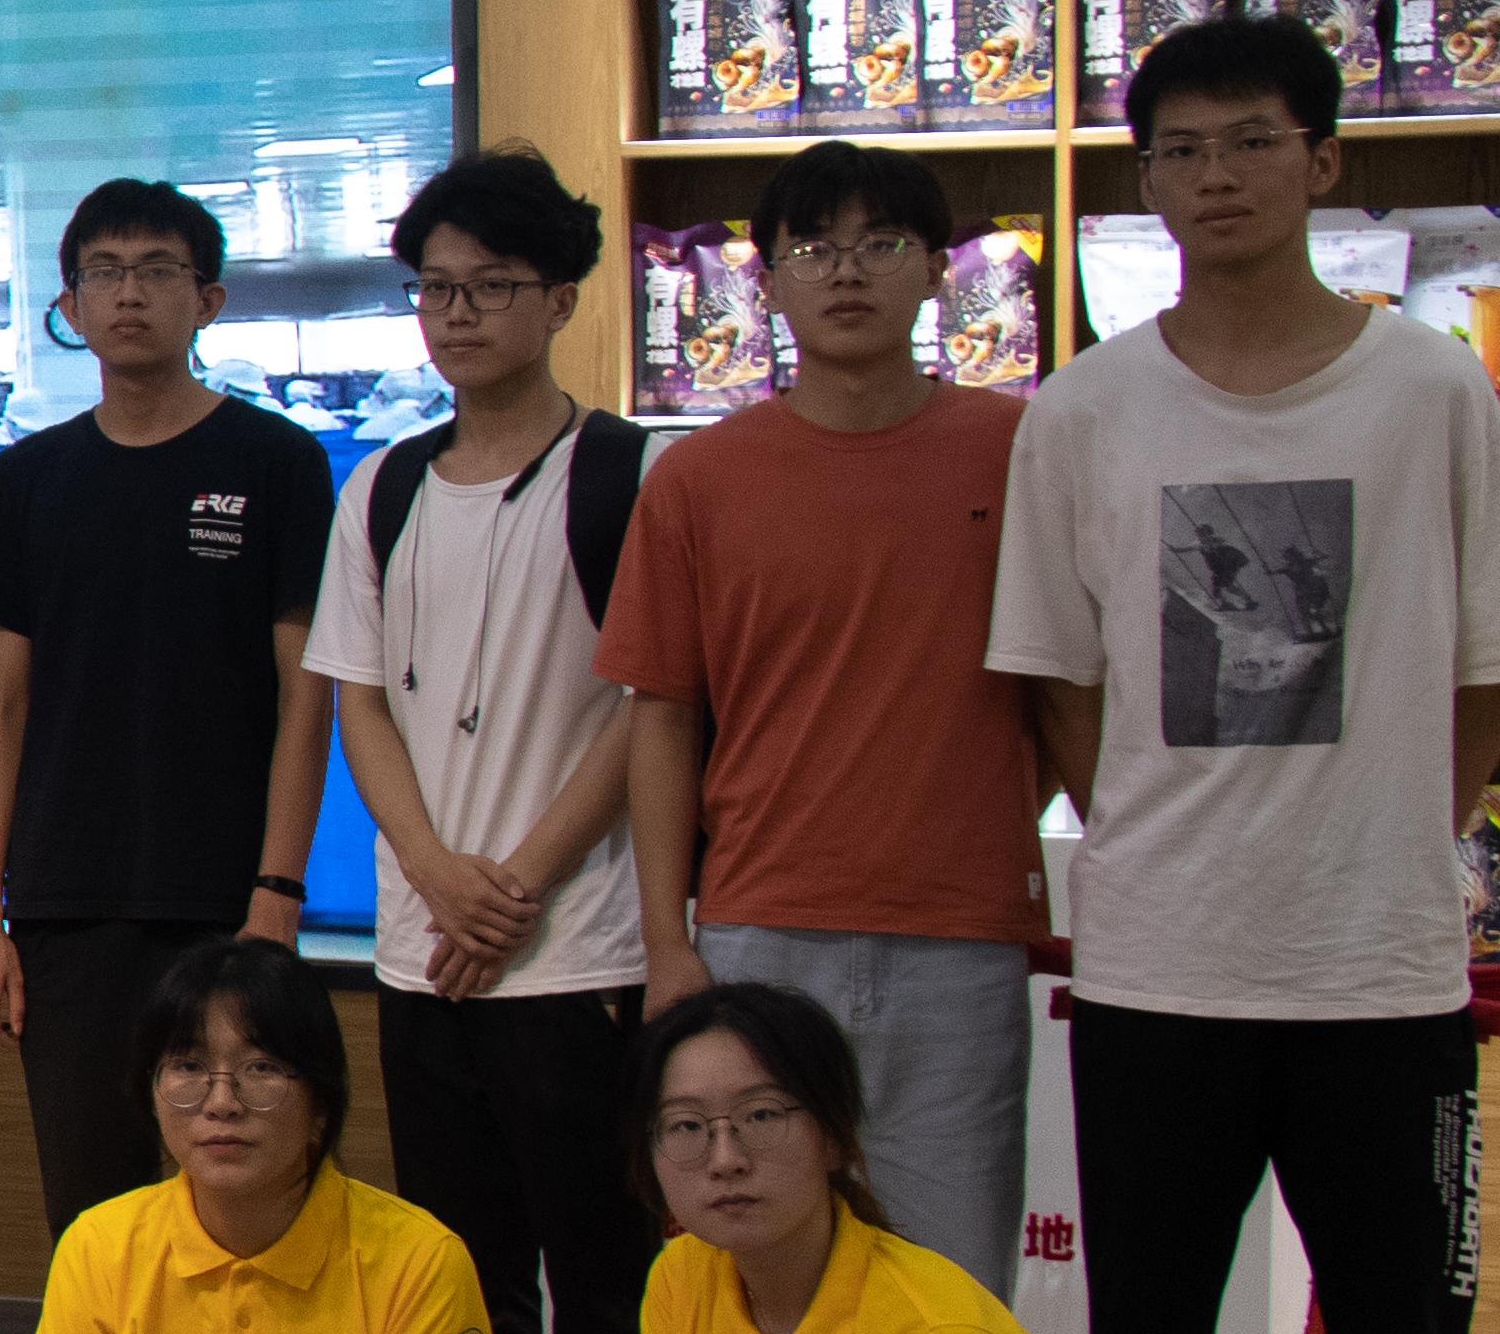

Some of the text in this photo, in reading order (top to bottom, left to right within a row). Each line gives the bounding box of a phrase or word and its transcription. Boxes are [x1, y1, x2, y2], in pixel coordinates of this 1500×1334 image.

[190, 493, 248, 516] ERKE
[188, 528, 243, 545] TRAINING
[1025, 1212, 1074, 1261] 地
